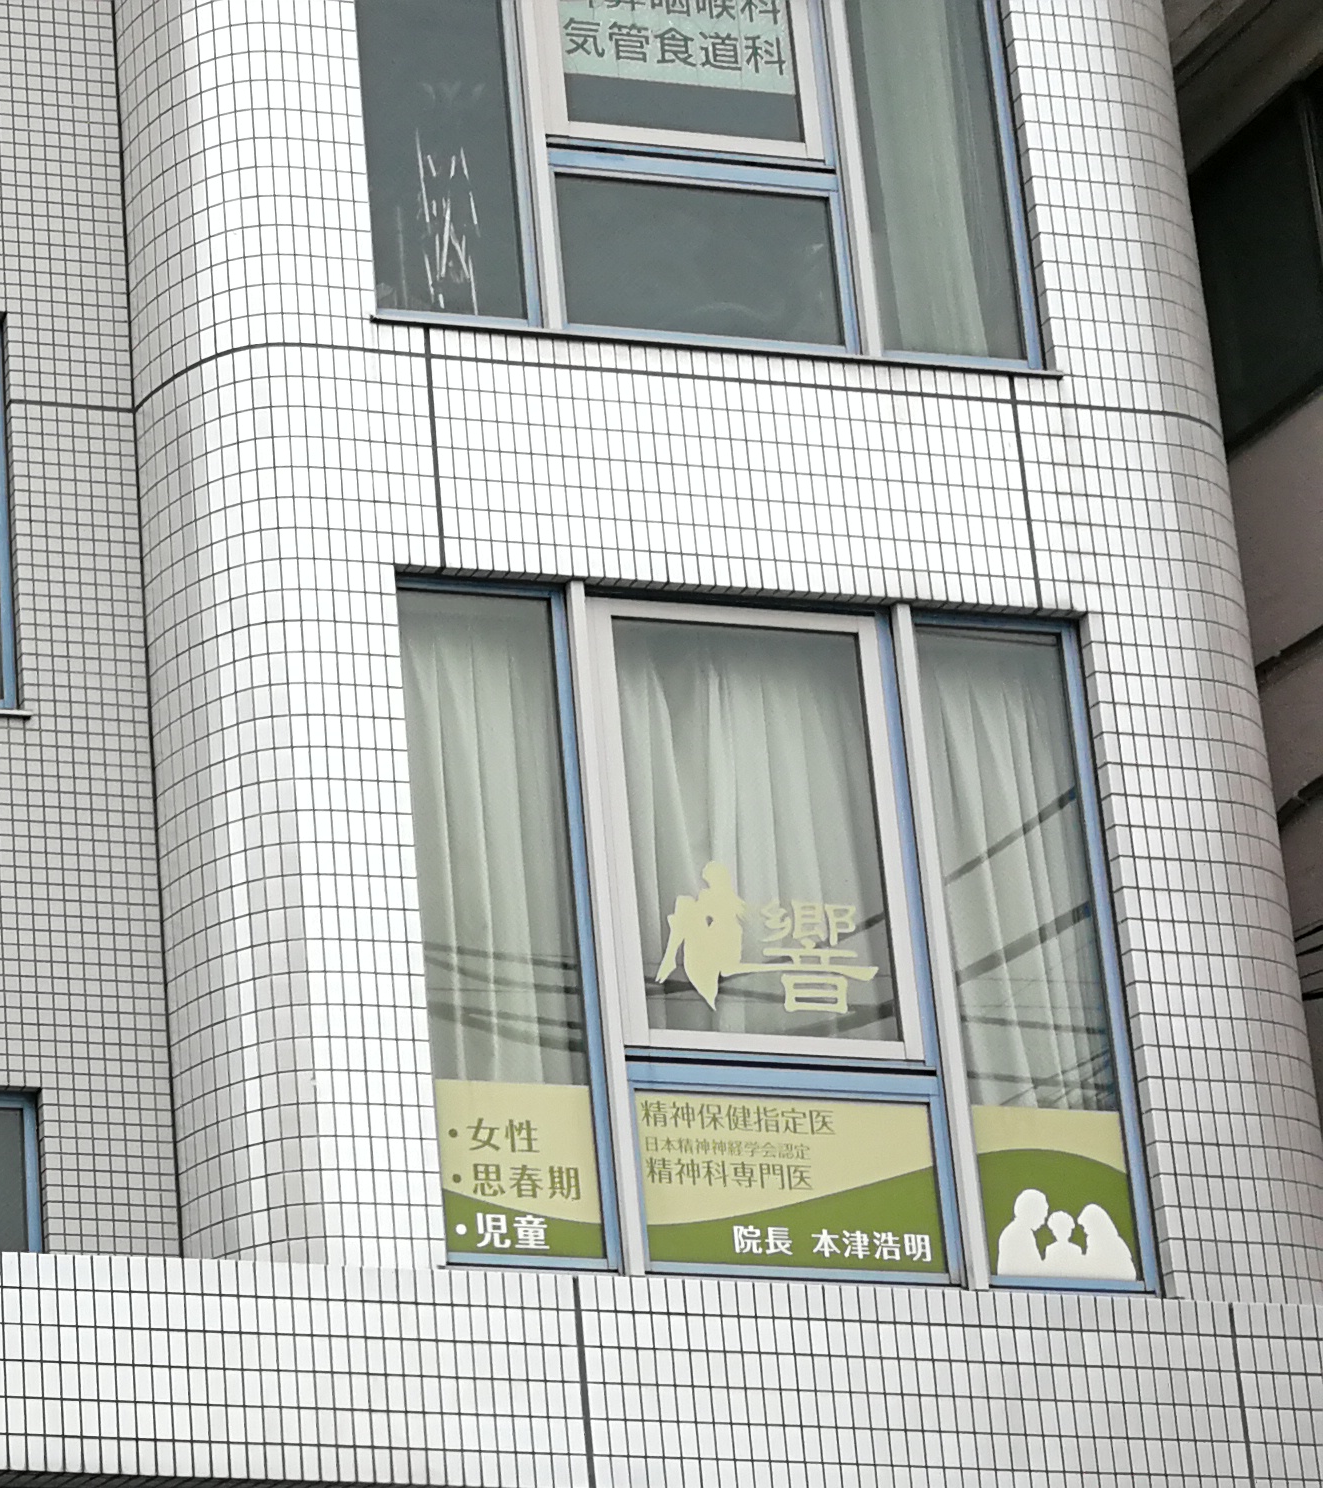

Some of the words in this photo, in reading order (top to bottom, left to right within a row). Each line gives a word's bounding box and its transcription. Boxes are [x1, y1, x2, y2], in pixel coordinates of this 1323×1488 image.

[563, 17, 787, 76] 気管食道科
[759, 901, 879, 1015] 響
[468, 1116, 540, 1154] 女性
[640, 1099, 836, 1137] 精神保健指定医
[644, 1136, 812, 1161] 日本精神神経学会認定
[470, 1163, 582, 1202] 思春期
[646, 1156, 814, 1191] 精神科専門医
[475, 1212, 551, 1251] 児童
[732, 1224, 793, 1256] 院長
[812, 1228, 933, 1263] 本津浩明
